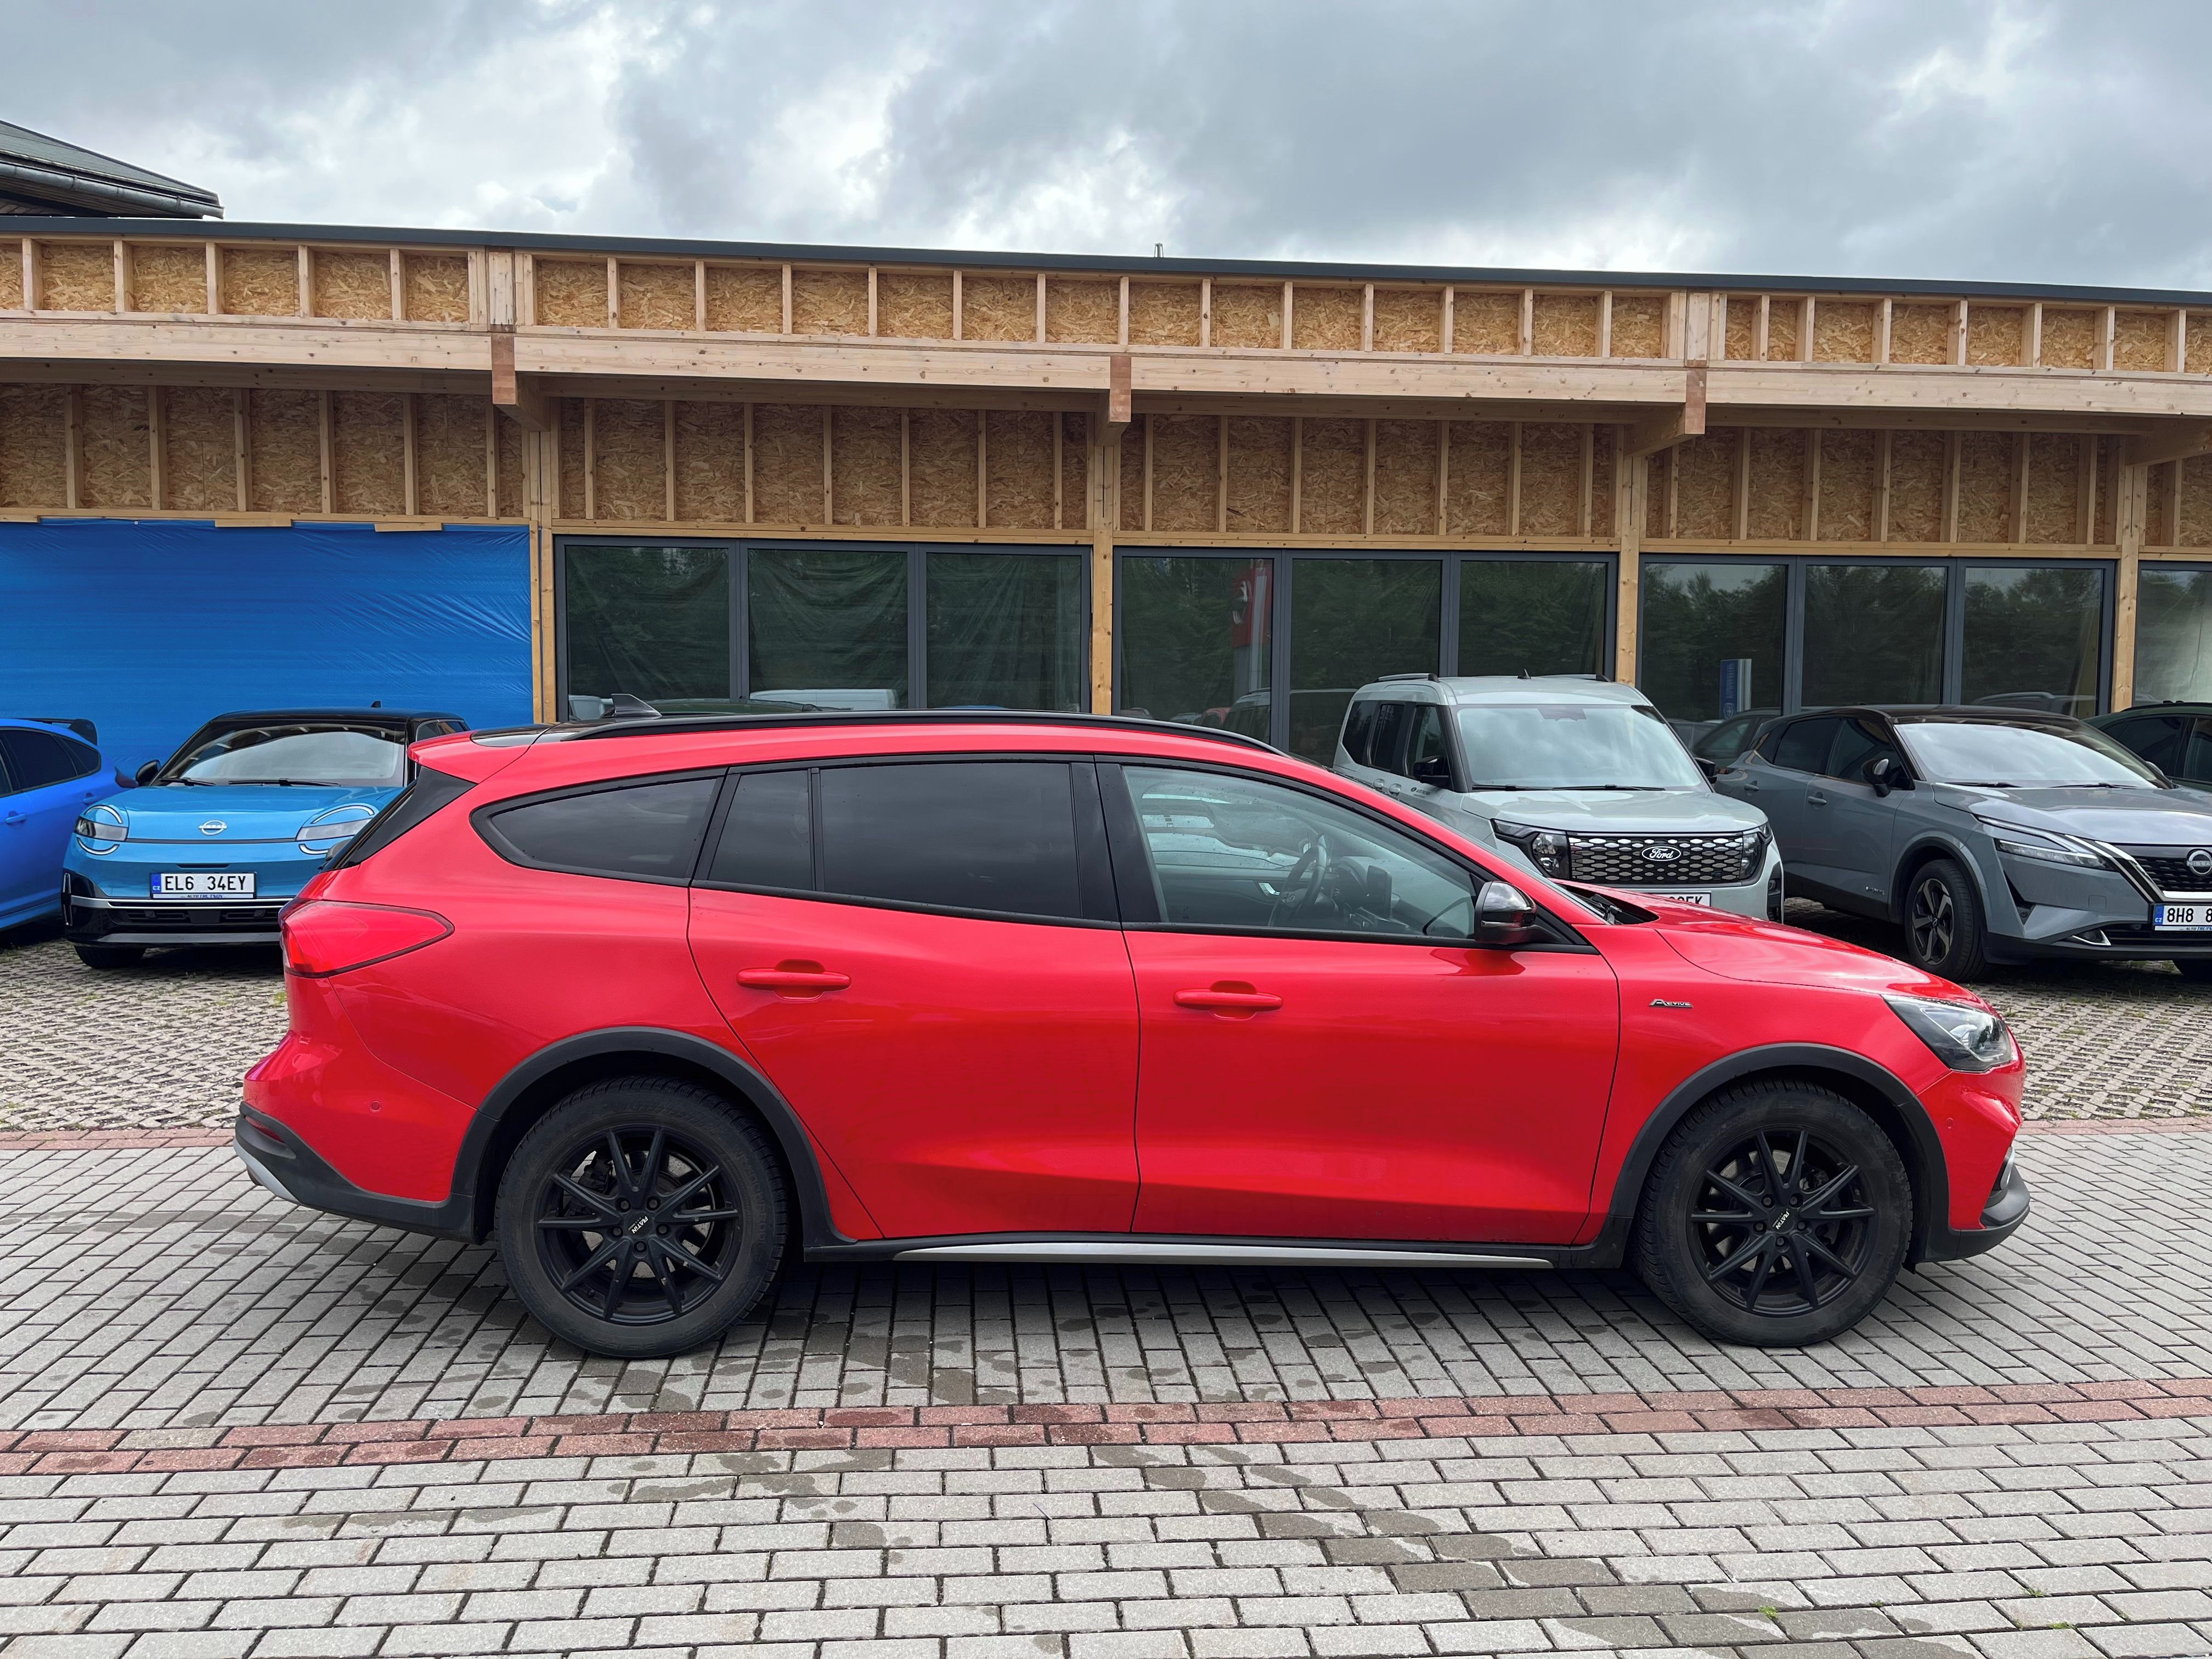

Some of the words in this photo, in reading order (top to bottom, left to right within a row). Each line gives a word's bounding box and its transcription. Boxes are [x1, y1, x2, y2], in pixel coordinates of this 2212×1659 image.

[1649, 848, 1674, 859] Ford
[165, 876, 194, 890] EL6
[207, 876, 246, 890] 34EY
[2167, 907, 2194, 923] 8H8
